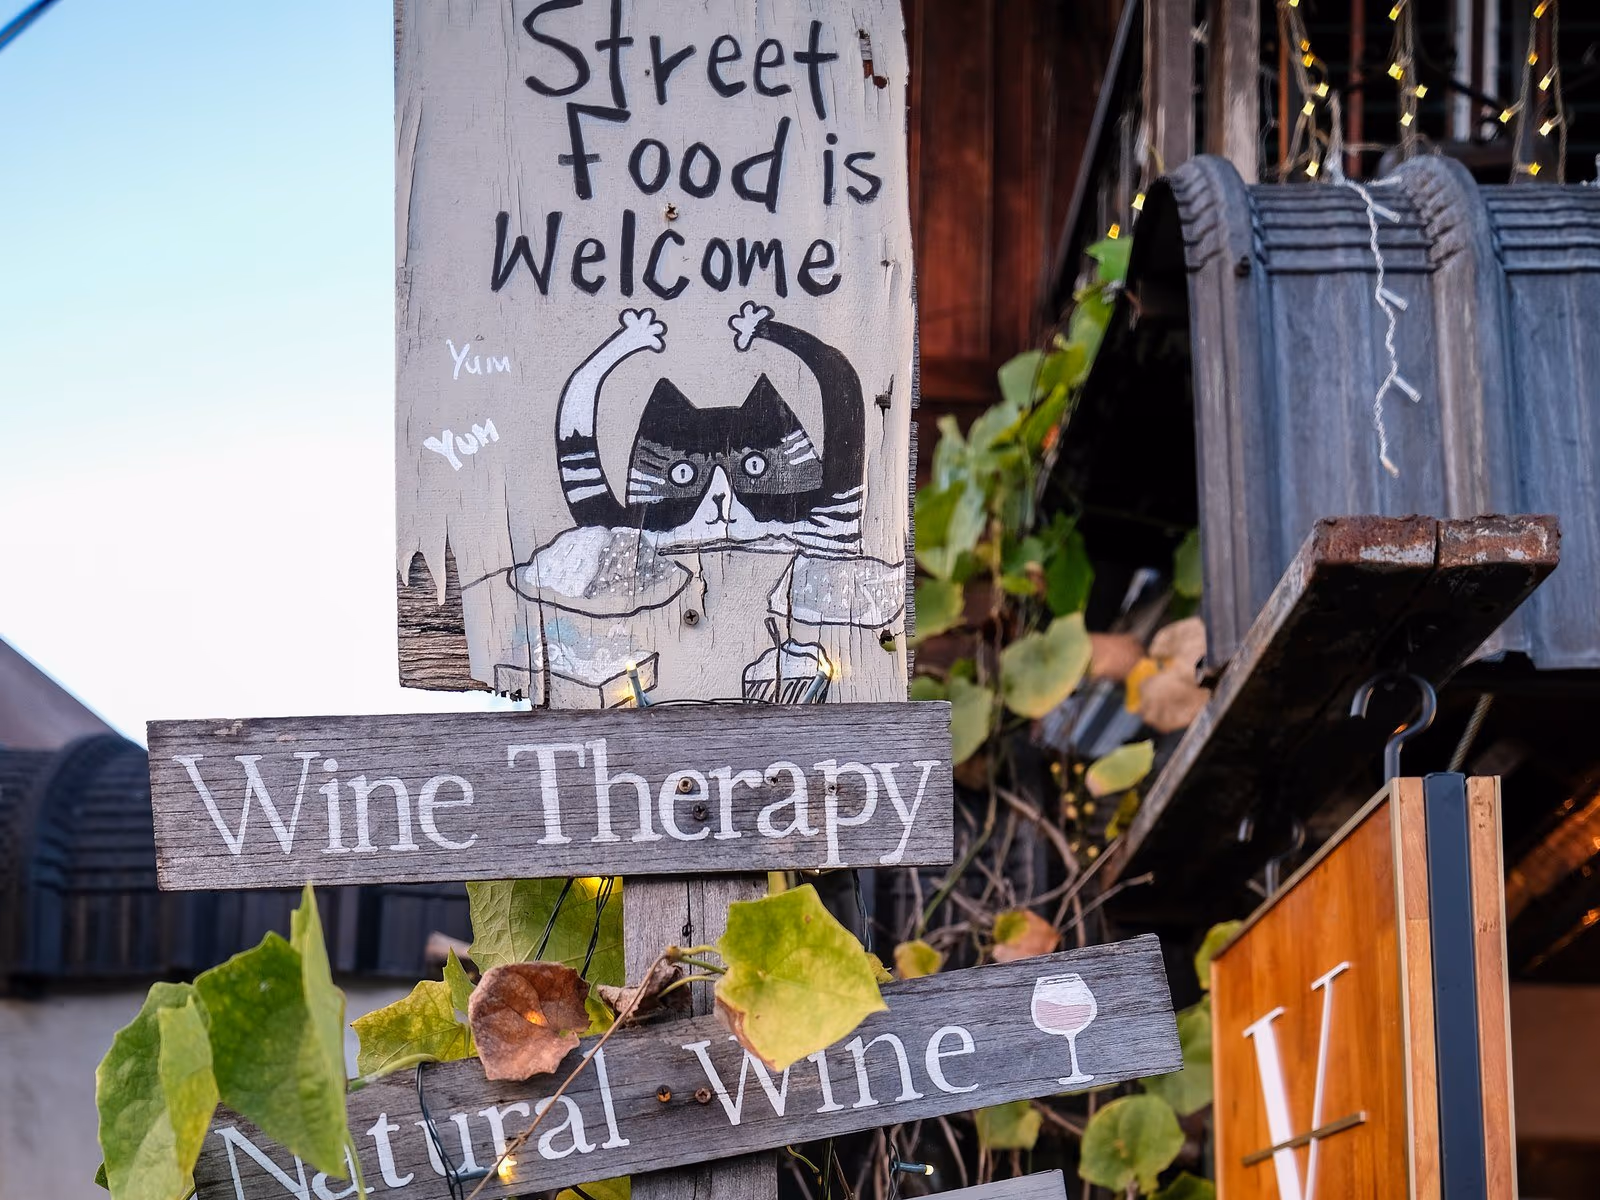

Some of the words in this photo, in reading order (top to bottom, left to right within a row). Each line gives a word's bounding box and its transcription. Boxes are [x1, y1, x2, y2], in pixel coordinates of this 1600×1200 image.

[523, 0, 839, 120] Street
[558, 102, 791, 213] Food
[823, 133, 882, 205] is
[490, 209, 842, 300] Welcome
[172, 751, 478, 855] Wine
[508, 738, 941, 867] Therapy
[682, 1025, 979, 1126] Wine
